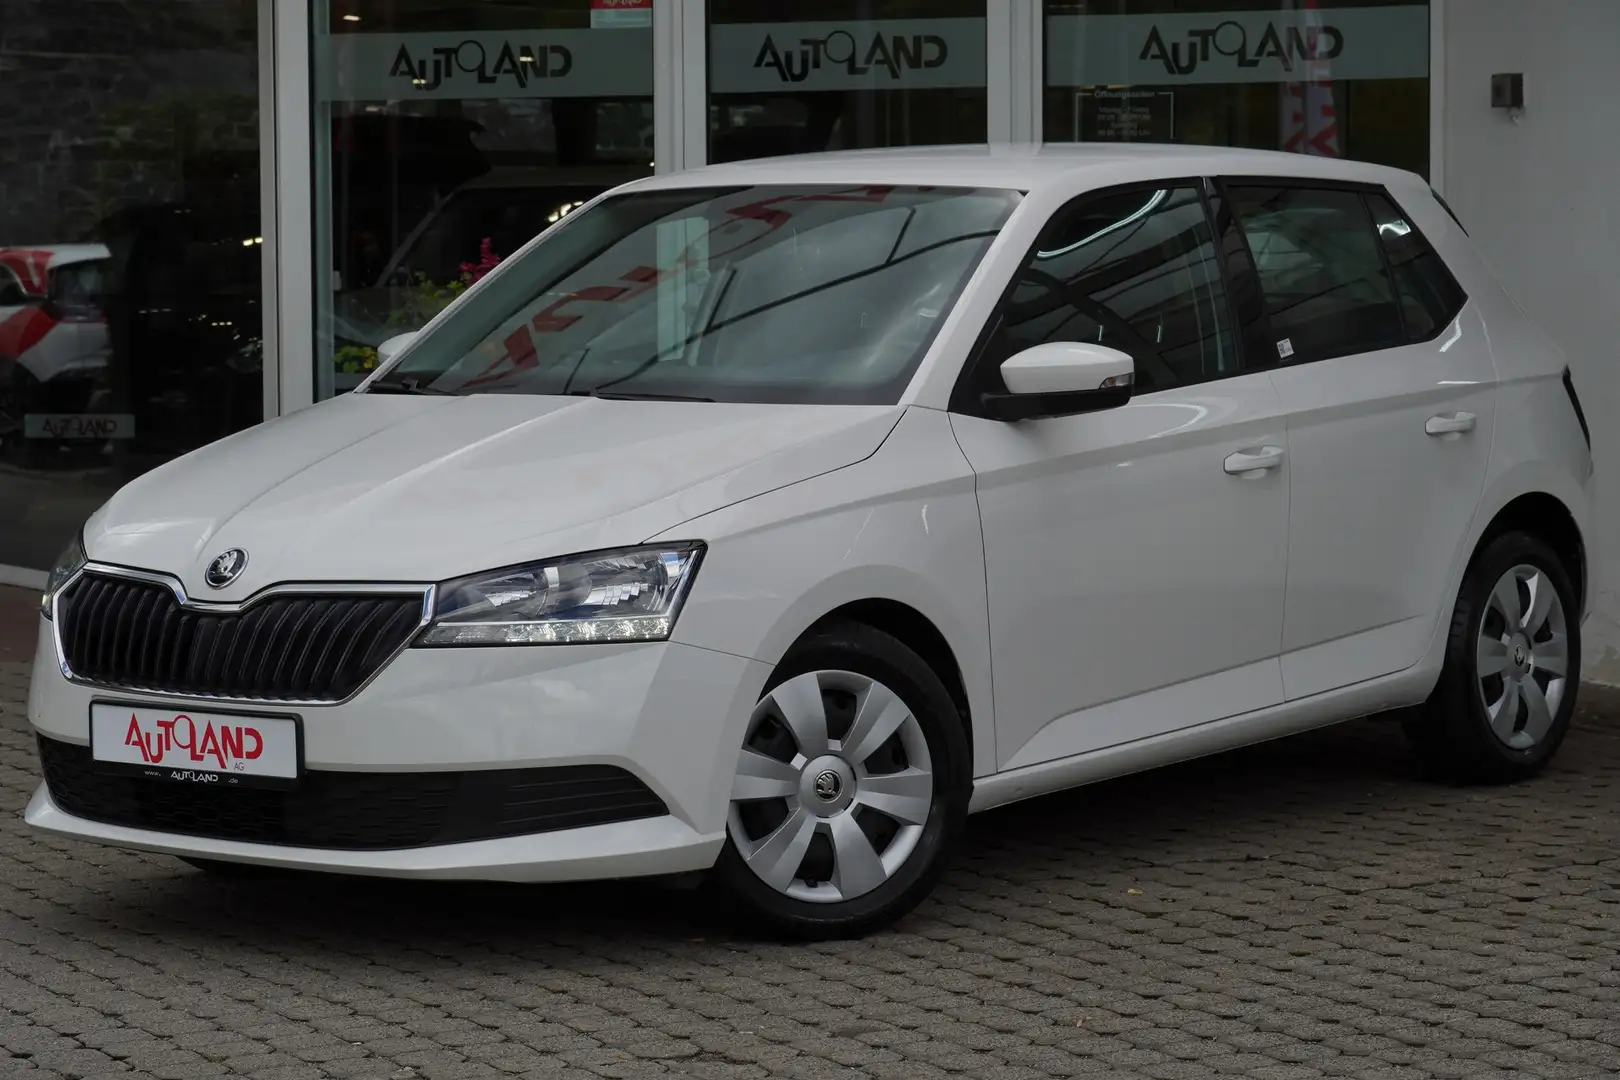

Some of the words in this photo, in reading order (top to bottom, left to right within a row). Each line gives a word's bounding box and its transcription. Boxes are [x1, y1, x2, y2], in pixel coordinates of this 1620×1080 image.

[389, 40, 572, 90] AUTOLAND
[753, 30, 949, 82] AUTOLAND
[1139, 21, 1344, 75] AUTOLAND
[125, 712, 264, 769] AUTOLAND
[171, 770, 218, 783] AUTOLAND
[234, 762, 244, 771] AG
